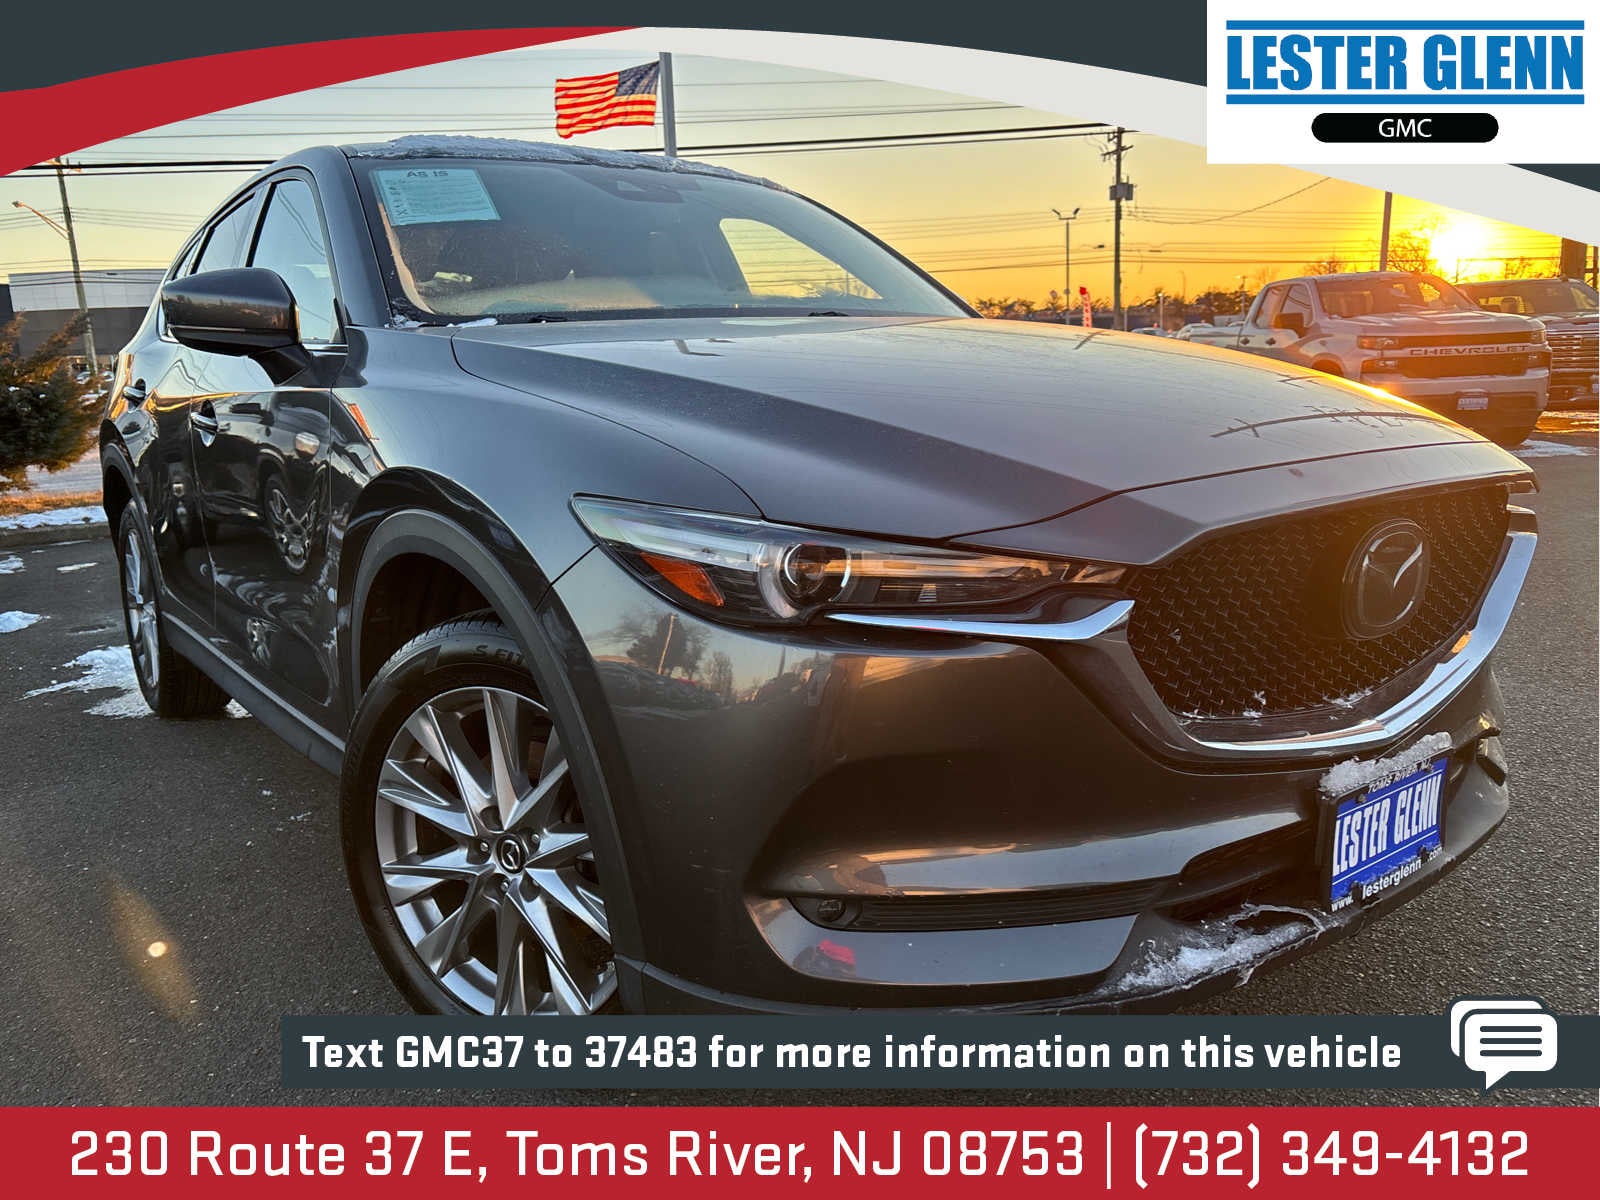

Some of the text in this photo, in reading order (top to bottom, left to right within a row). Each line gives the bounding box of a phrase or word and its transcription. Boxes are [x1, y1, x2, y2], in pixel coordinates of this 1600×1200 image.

[407, 170, 449, 178] AS IS
[1409, 344, 1530, 357] CHEVROLET
[1332, 773, 1443, 877] LESTER GLENN
